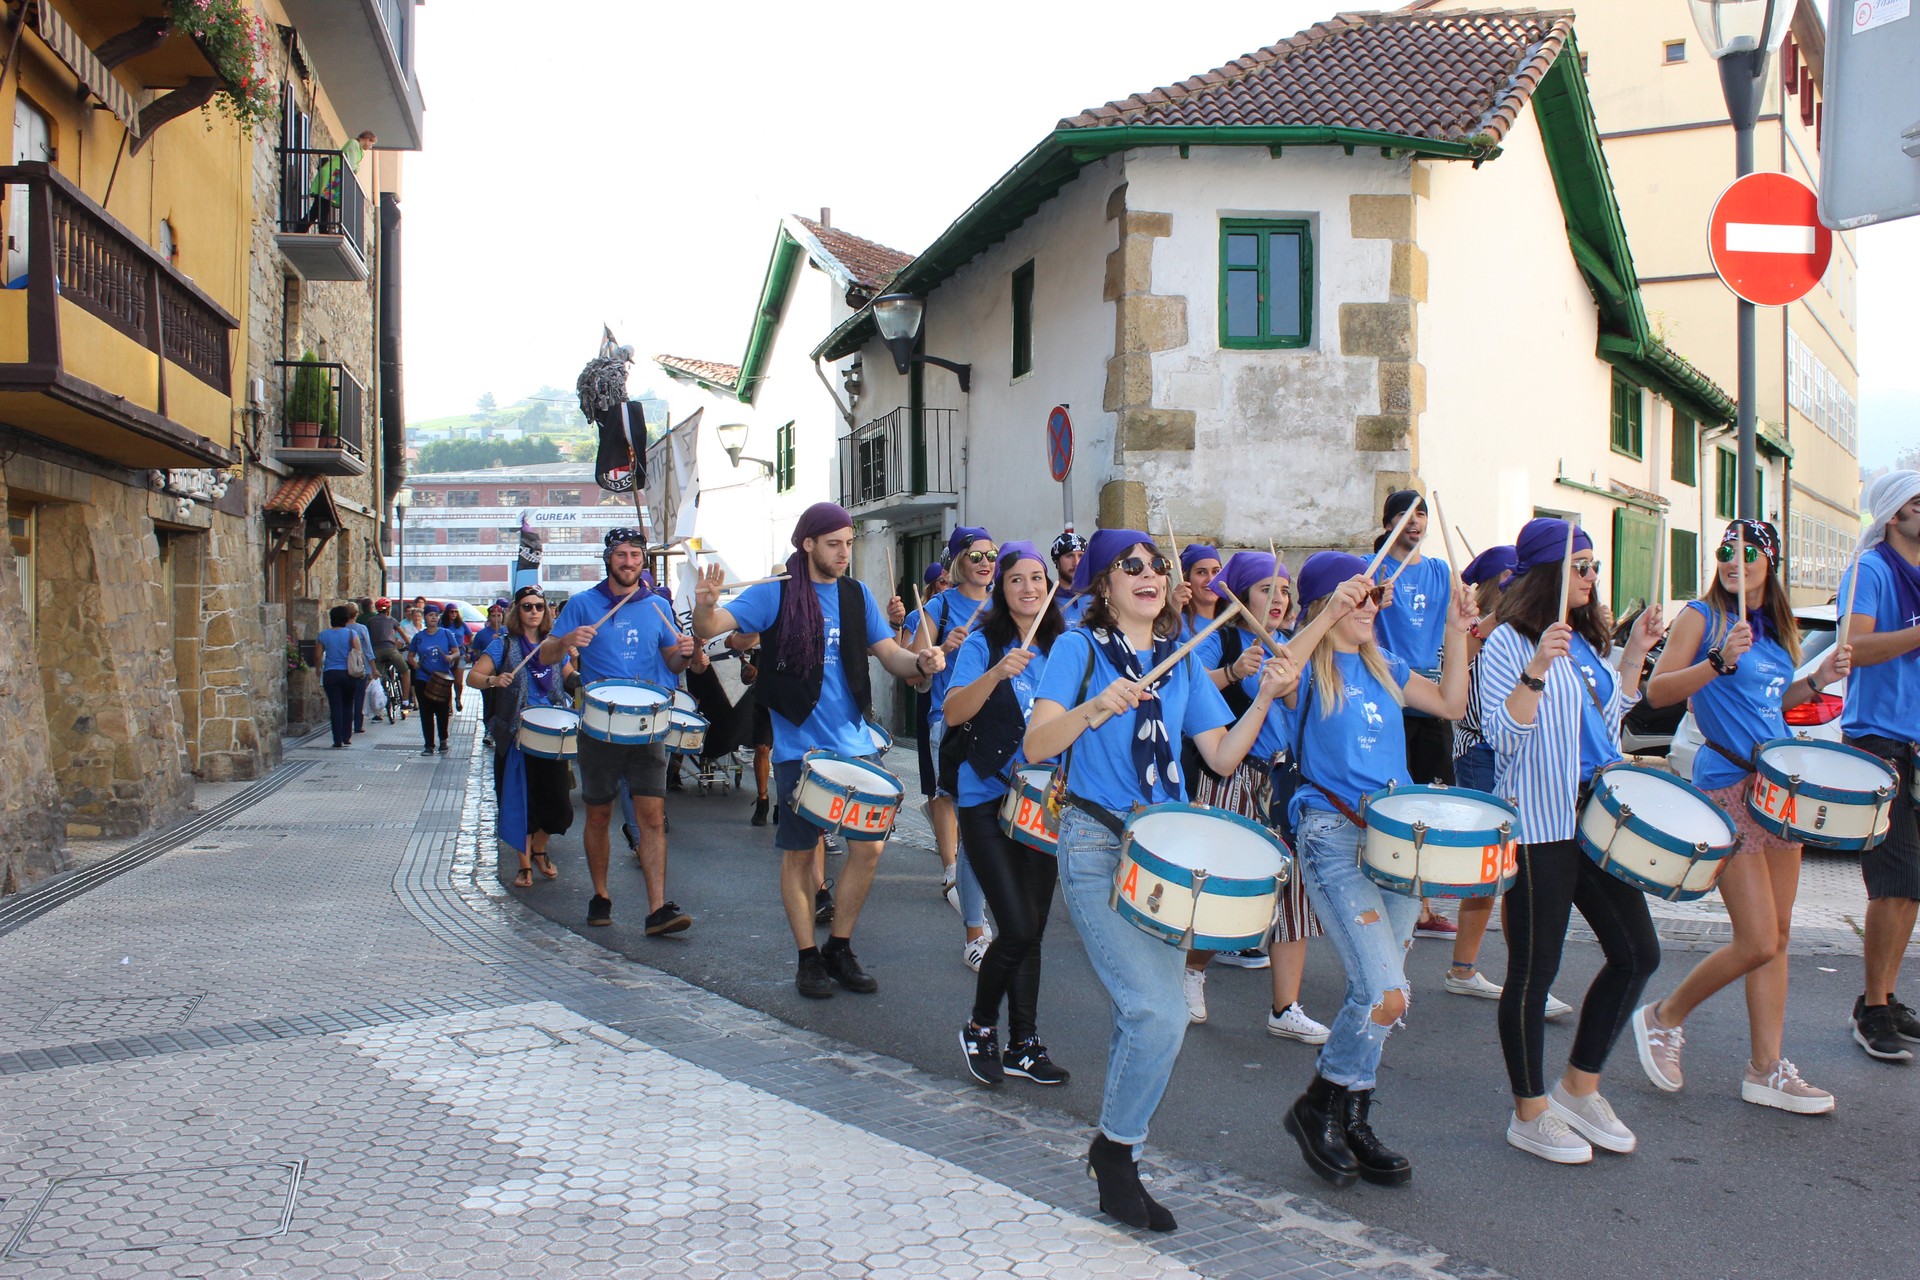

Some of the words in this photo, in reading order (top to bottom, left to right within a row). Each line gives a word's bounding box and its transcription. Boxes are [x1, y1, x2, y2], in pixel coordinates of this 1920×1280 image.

[536, 513, 577, 521] GUREAK
[1753, 772, 1797, 825] LEA
[1017, 797, 1059, 840] BA
[1018, 1055, 1035, 1070] N
